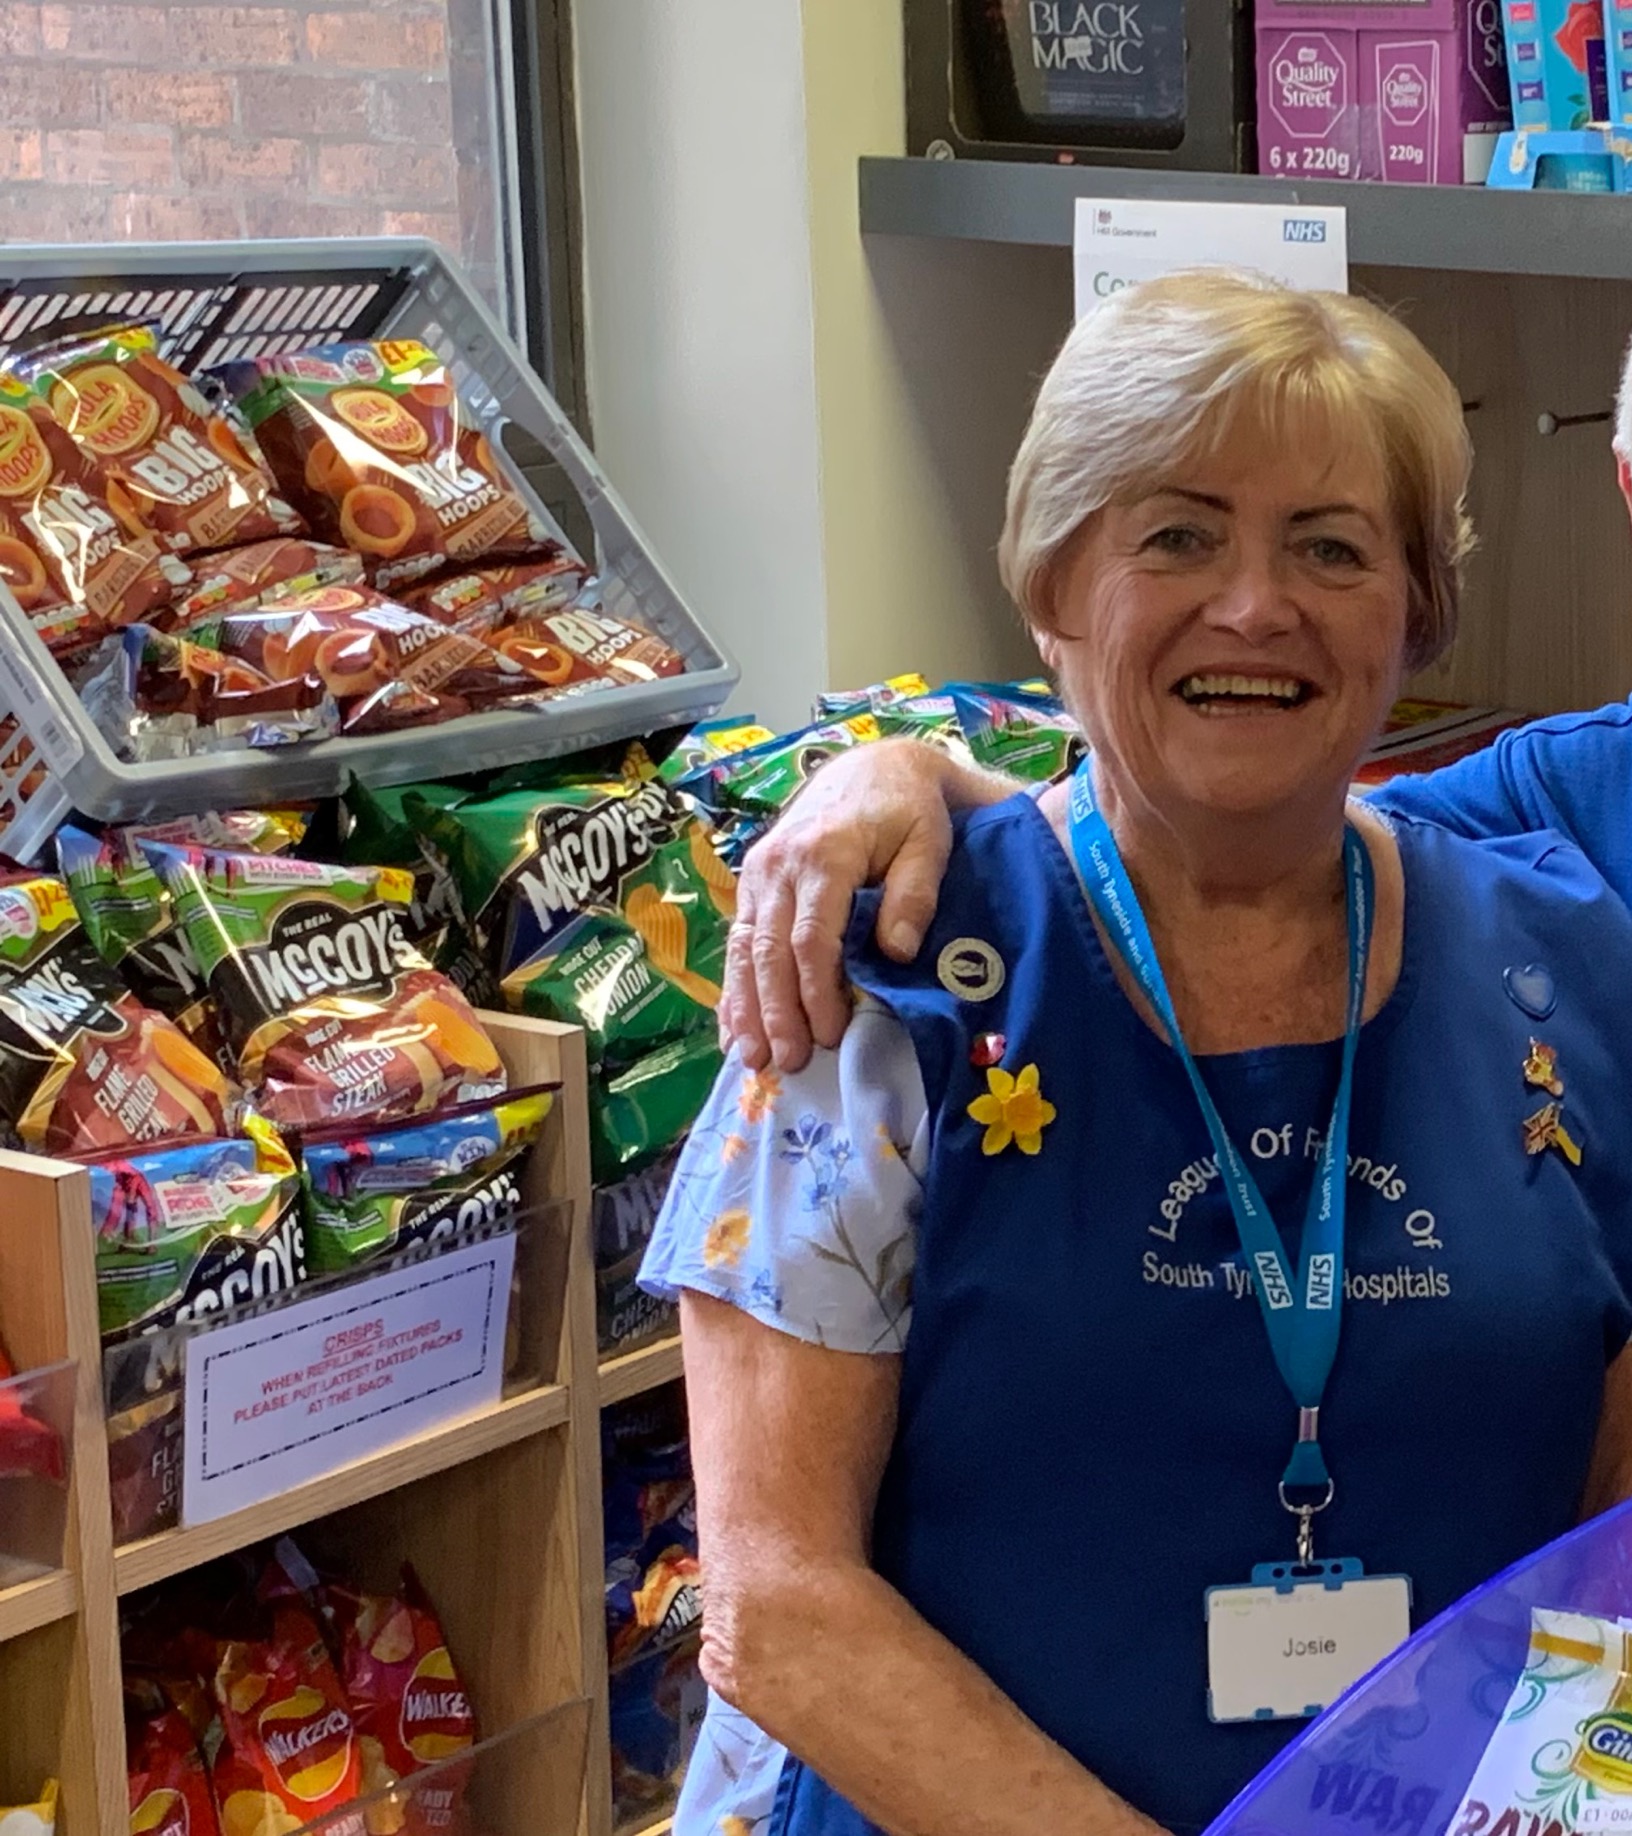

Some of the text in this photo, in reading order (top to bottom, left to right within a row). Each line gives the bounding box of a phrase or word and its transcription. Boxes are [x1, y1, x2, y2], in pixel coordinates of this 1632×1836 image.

[1029, 1, 1143, 38] BLACK
[1032, 36, 1144, 74] MAGIC
[1276, 59, 1339, 86] Quality
[1282, 85, 1332, 108] Street
[1386, 81, 1422, 96] Quality
[1270, 147, 1350, 175] 6 x 220g
[1389, 145, 1424, 163] 220g
[1112, 227, 1157, 239] Government
[1284, 219, 1326, 242] NHS
[92, 393, 148, 447] HOOPS
[131, 425, 224, 495] BIG
[402, 449, 489, 509] BIG
[437, 484, 501, 528] HOOPS
[1074, 775, 1095, 823] NHS
[1089, 839, 1109, 880] South
[1102, 877, 1132, 936] Tyneside
[303, 912, 332, 931] REAL
[329, 1046, 396, 1089] GRILLED
[330, 1069, 388, 1117] STEAK
[1251, 1123, 1293, 1158] Of
[1405, 1209, 1443, 1249] Of
[1318, 1173, 1332, 1221] South
[1143, 1251, 1214, 1288] South
[1256, 1252, 1292, 1308] NHS
[1308, 1255, 1334, 1308] NHS
[324, 1318, 384, 1352] CRISPS
[234, 1329, 463, 1425] PLEASE PUT LATEST DATED PACKS
[261, 1319, 441, 1396] WHEN REFILLING FIXTURES
[307, 1375, 394, 1416] AT THE BACK
[1283, 1637, 1337, 1658] Josie
[265, 1708, 350, 1767] WALKERS
